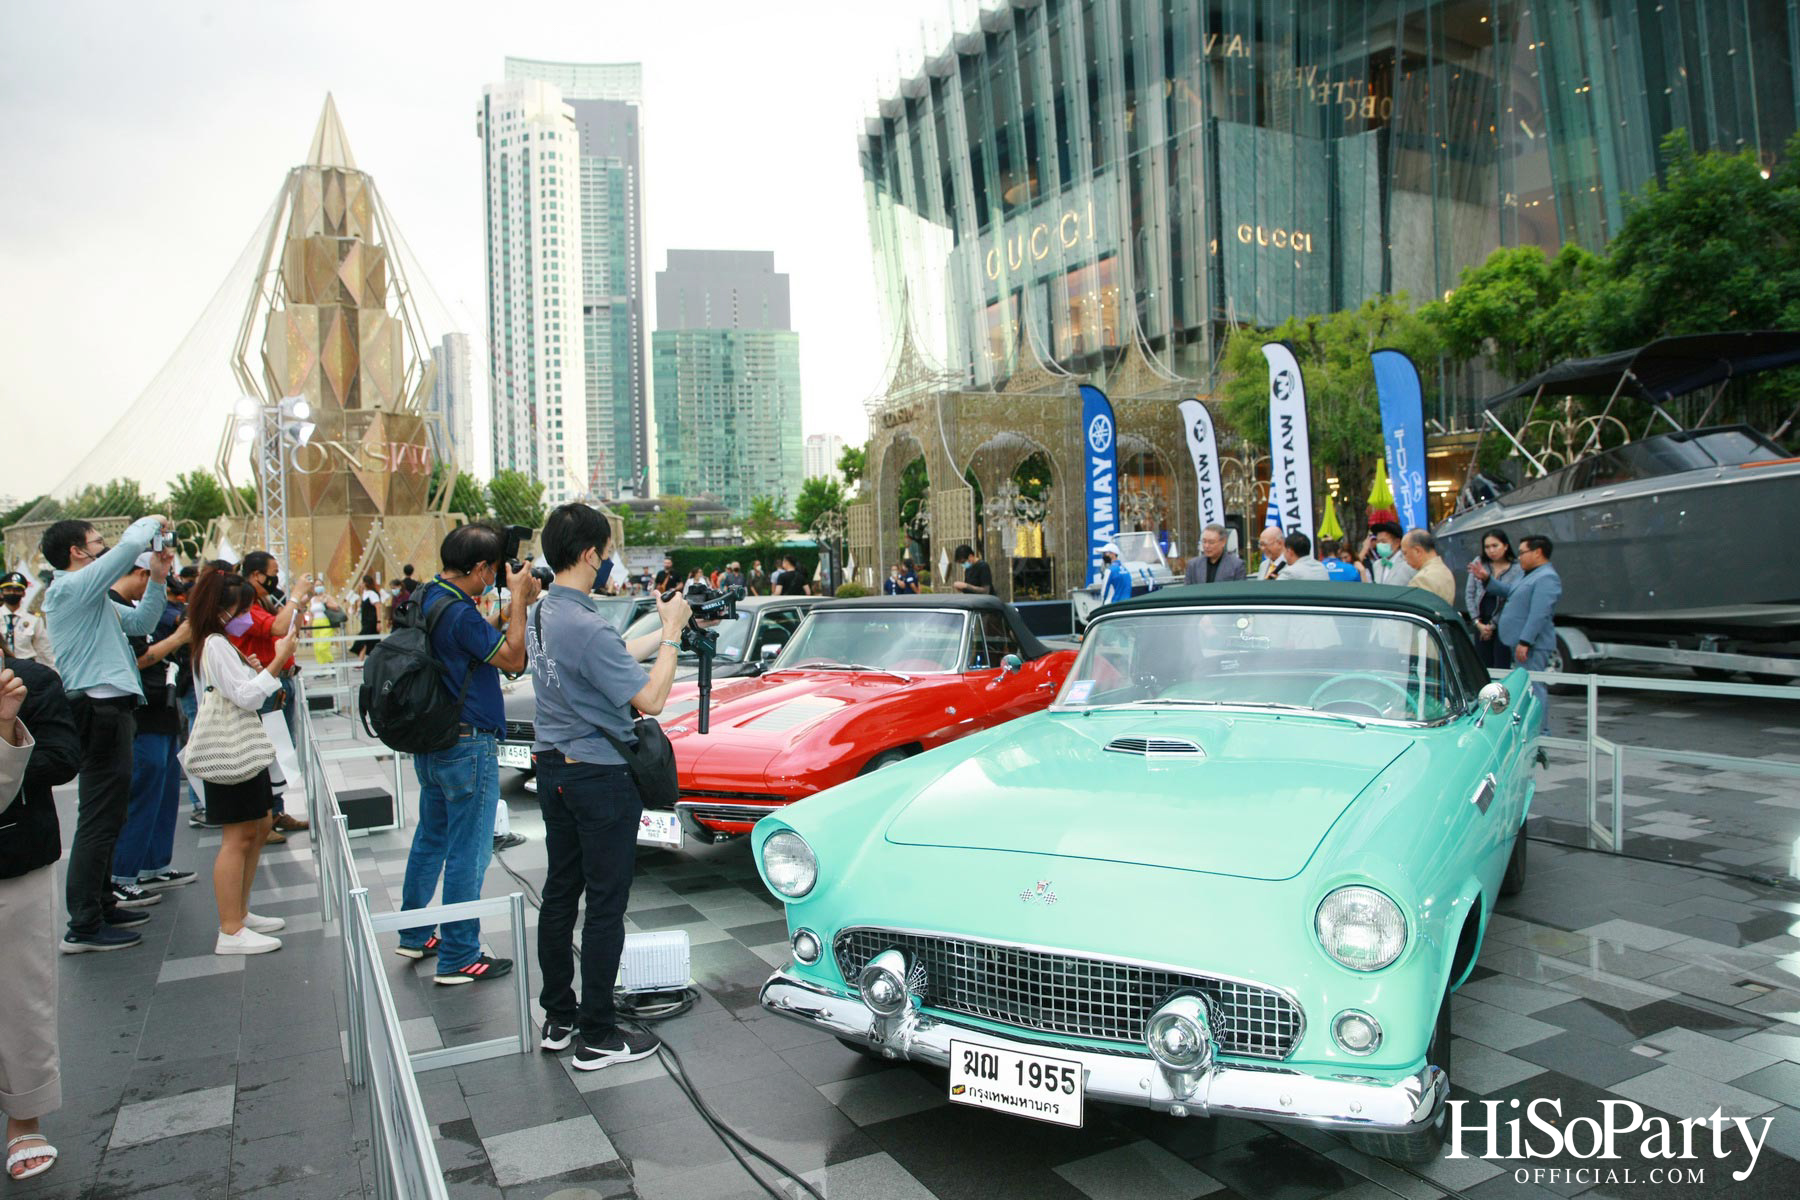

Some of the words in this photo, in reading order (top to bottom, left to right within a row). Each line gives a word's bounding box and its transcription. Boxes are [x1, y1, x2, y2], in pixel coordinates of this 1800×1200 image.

[1237, 224, 1312, 252] GUCCI
[1015, 1060, 1075, 1095] 1955
[969, 1085, 1060, 1115] กรุงเทพมหานคร
